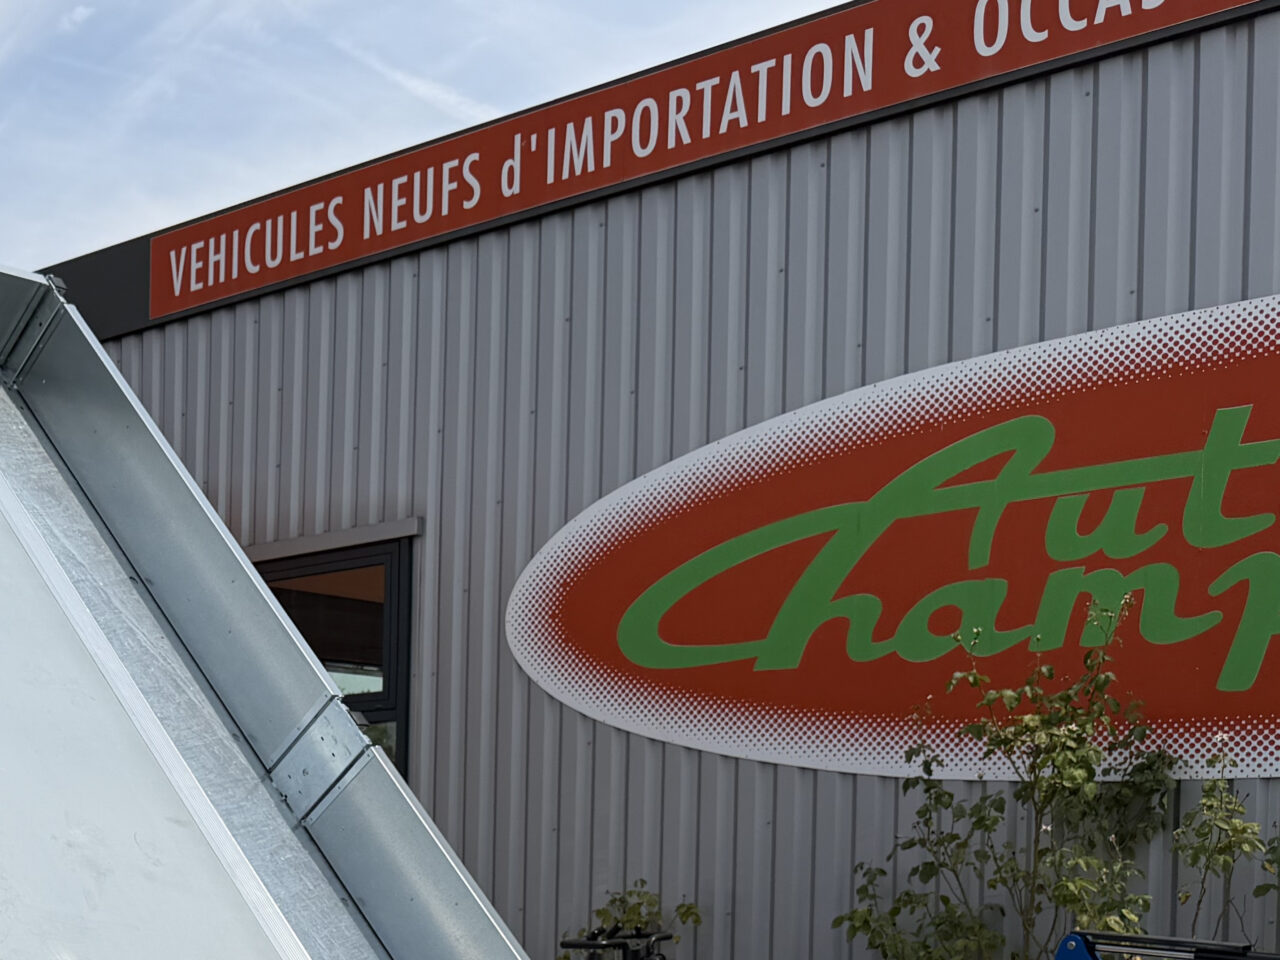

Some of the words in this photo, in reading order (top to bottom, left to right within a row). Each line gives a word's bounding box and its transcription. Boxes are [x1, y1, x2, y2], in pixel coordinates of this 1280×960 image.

[170, 196, 344, 297] VEHICULES
[363, 152, 481, 240] NEUFS
[501, 28, 874, 197] d'IMPORTATION
[903, 15, 942, 78] &
